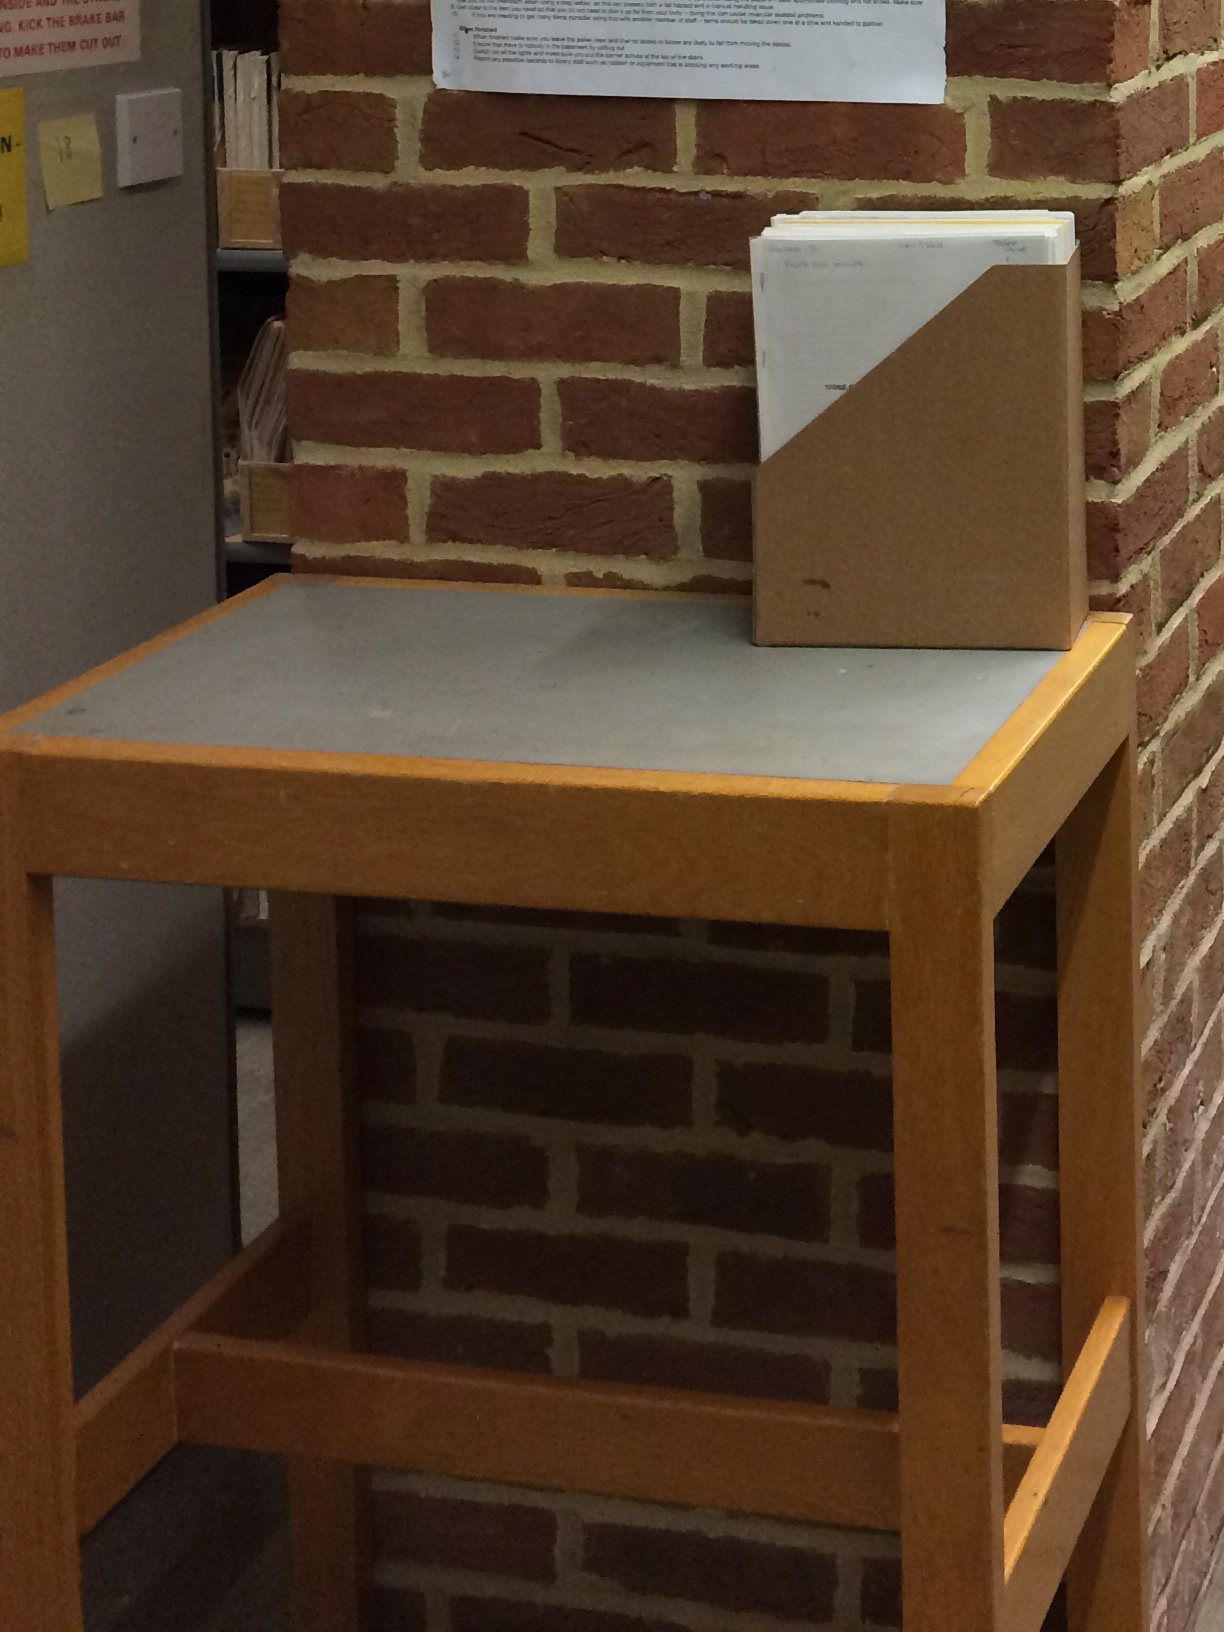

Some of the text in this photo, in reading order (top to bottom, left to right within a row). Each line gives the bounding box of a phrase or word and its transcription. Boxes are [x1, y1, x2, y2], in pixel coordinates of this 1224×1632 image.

[18, 18, 43, 31] KICK
[46, 16, 66, 29] THE
[69, 13, 102, 27] BRAKE
[105, 11, 125, 23] BAR
[14, 44, 45, 58] MAKE
[47, 41, 76, 54] THEM
[79, 38, 99, 50] CUT
